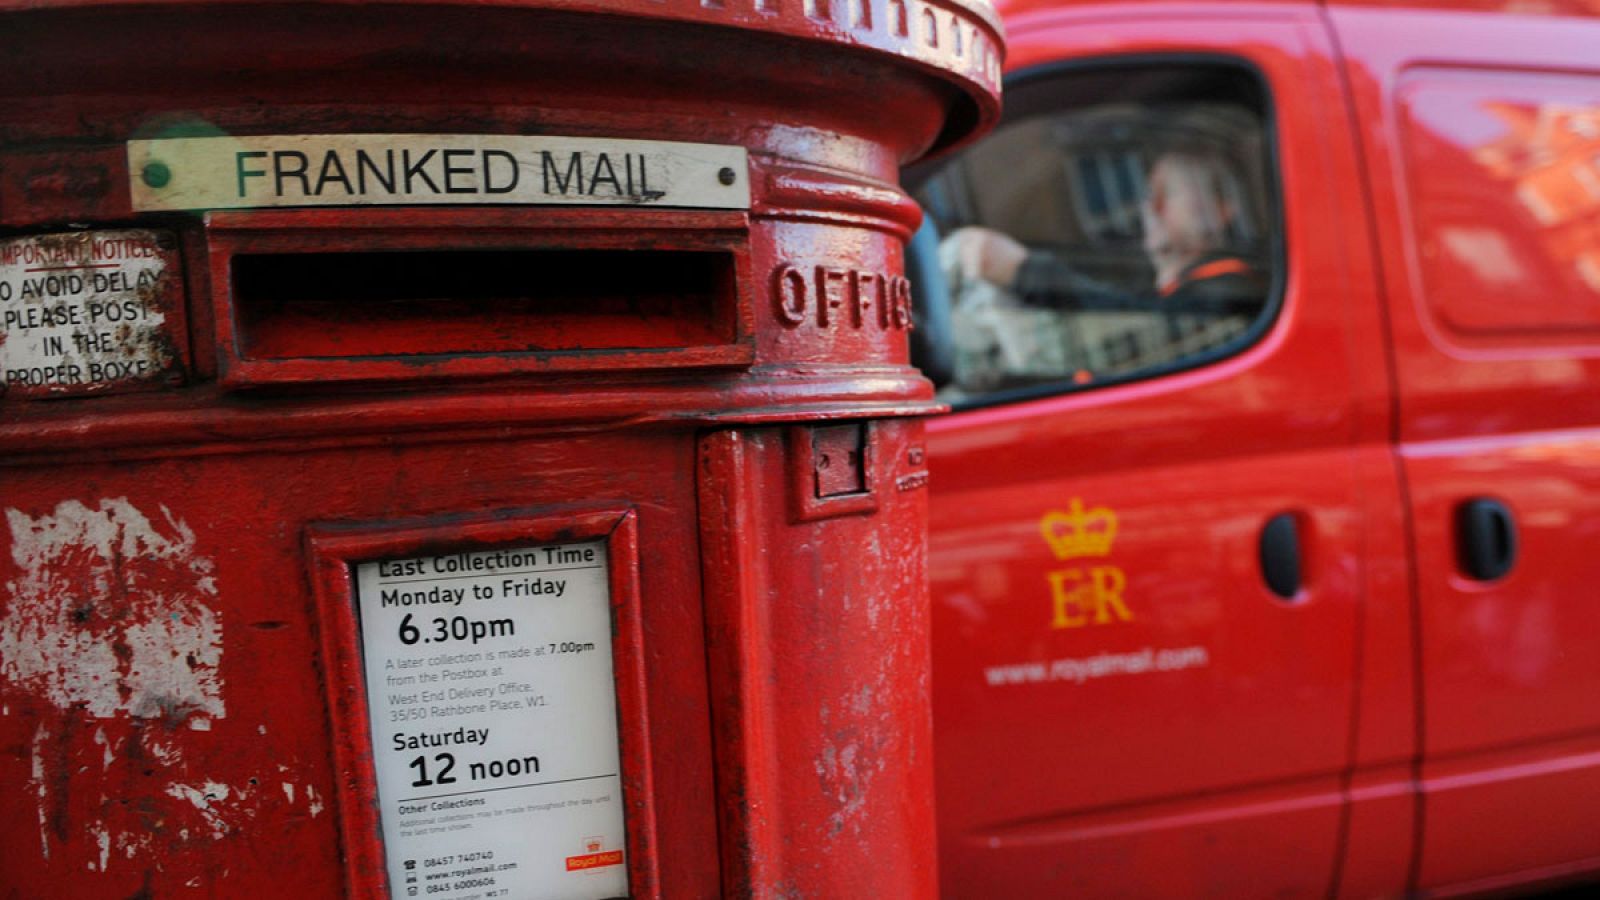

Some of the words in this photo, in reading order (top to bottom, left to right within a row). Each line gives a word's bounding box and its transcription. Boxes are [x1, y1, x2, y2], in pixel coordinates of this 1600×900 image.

[235, 148, 520, 198] FRANKED
[541, 151, 664, 198] MAIL
[0, 240, 83, 265] MPORTANT
[0, 281, 12, 301] O
[21, 275, 83, 299] AVOID
[5, 305, 80, 330] PLEASE
[91, 302, 149, 323] POST
[43, 336, 62, 356] IN
[72, 333, 112, 354] THE
[6, 365, 82, 386] PROPER
[379, 557, 426, 578] Last
[434, 552, 536, 574] Collection
[543, 547, 595, 565] Time
[381, 587, 465, 608] Monday
[472, 584, 493, 600] to
[503, 578, 567, 597] Friday
[1048, 565, 1134, 630] ER
[399, 613, 515, 645] 6.30pm
[386, 658, 394, 669] A
[397, 658, 424, 668] later
[428, 653, 480, 666] collection
[485, 651, 495, 661] is
[499, 647, 531, 659] made
[534, 647, 544, 656] at
[548, 642, 594, 654] 7.00pm
[387, 675, 416, 686] from
[419, 672, 438, 683] the
[442, 669, 487, 681] Postbox
[491, 667, 503, 677] at
[388, 694, 418, 705] West
[421, 690, 444, 702] End
[448, 687, 495, 700] Delivery
[389, 707, 426, 722] 35/50
[431, 703, 486, 717] Rathbone
[393, 727, 489, 751] Saturday
[409, 752, 456, 788] 12
[469, 755, 540, 780] noon
[398, 806, 427, 815] Other
[431, 798, 485, 811] Collections
[424, 853, 454, 868] 08457
[458, 851, 494, 862] 740740
[568, 856, 597, 868] Royal
[600, 851, 621, 863] Mail
[425, 863, 518, 881] www.royalmail.com
